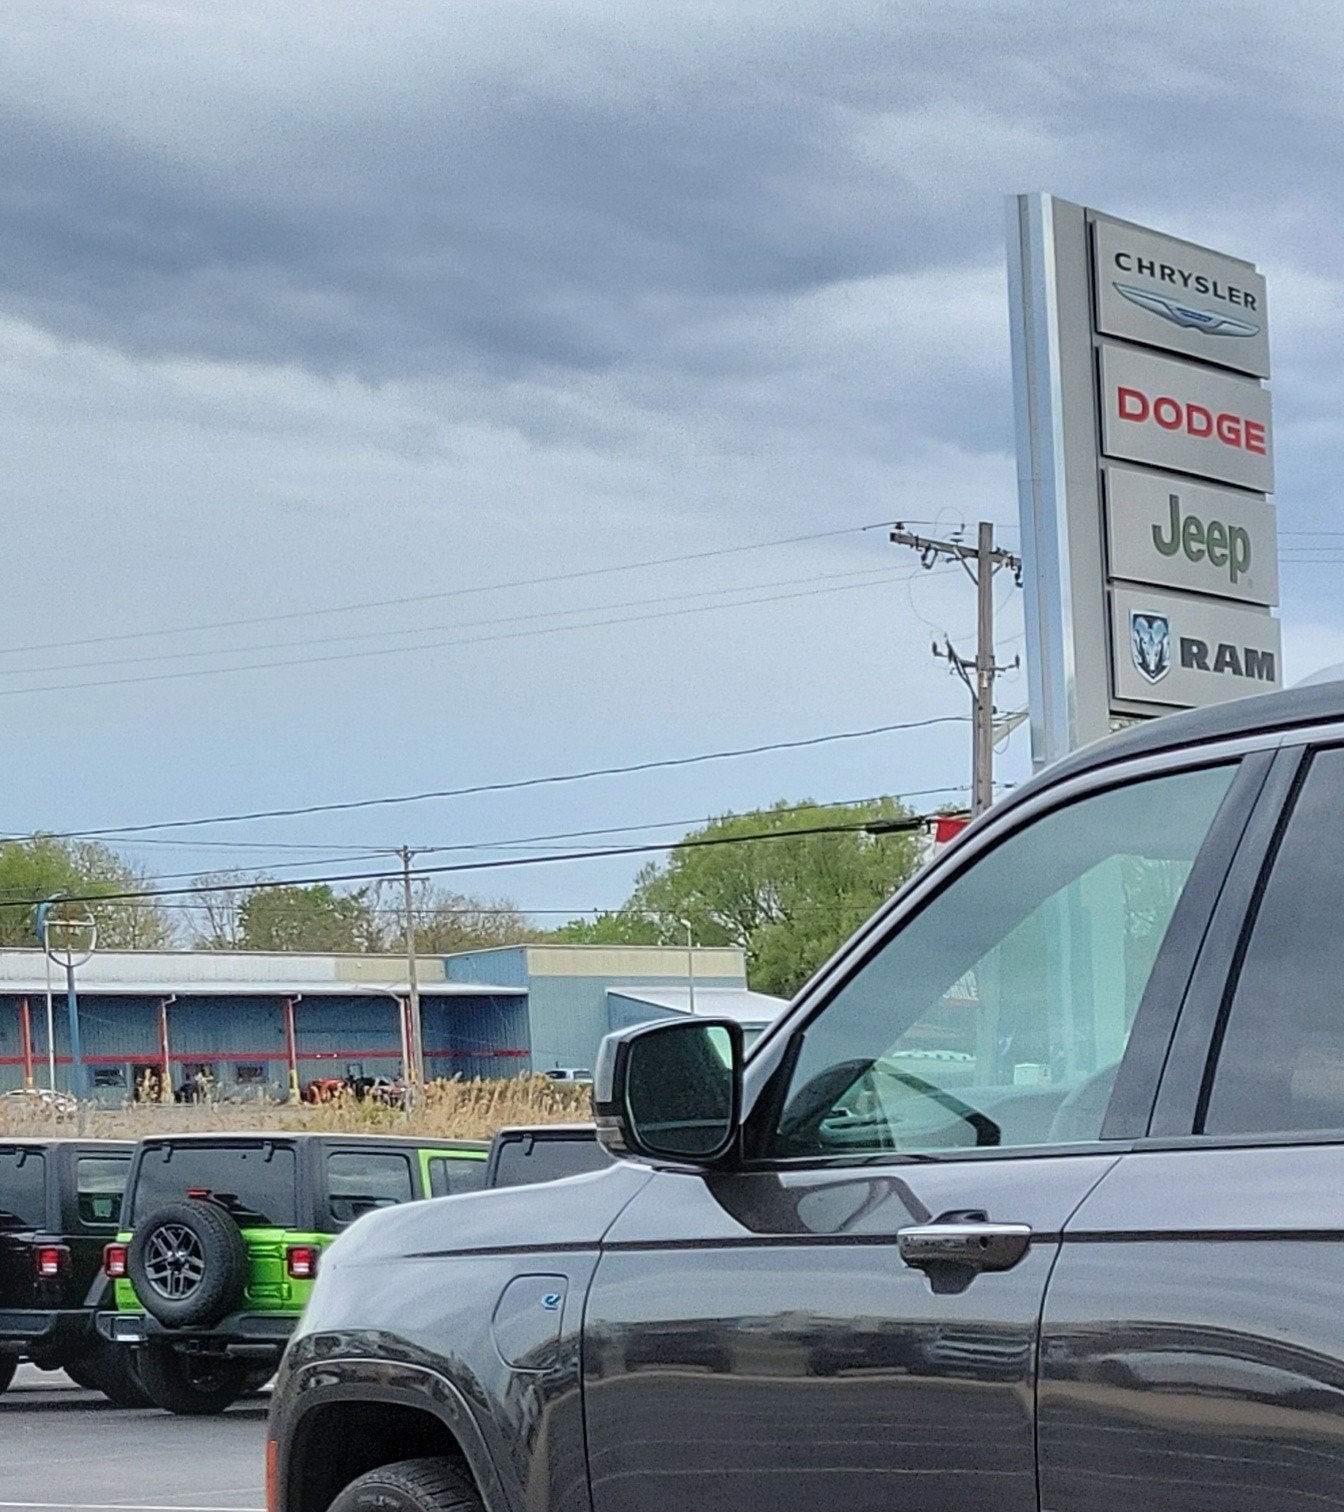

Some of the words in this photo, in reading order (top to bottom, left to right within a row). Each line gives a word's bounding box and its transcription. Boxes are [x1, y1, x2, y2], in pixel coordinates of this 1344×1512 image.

[1114, 251, 1258, 312] CHRYSLER
[1117, 385, 1267, 456] DODGE
[1151, 494, 1251, 584] Jeep
[1179, 636, 1275, 683] RAM
